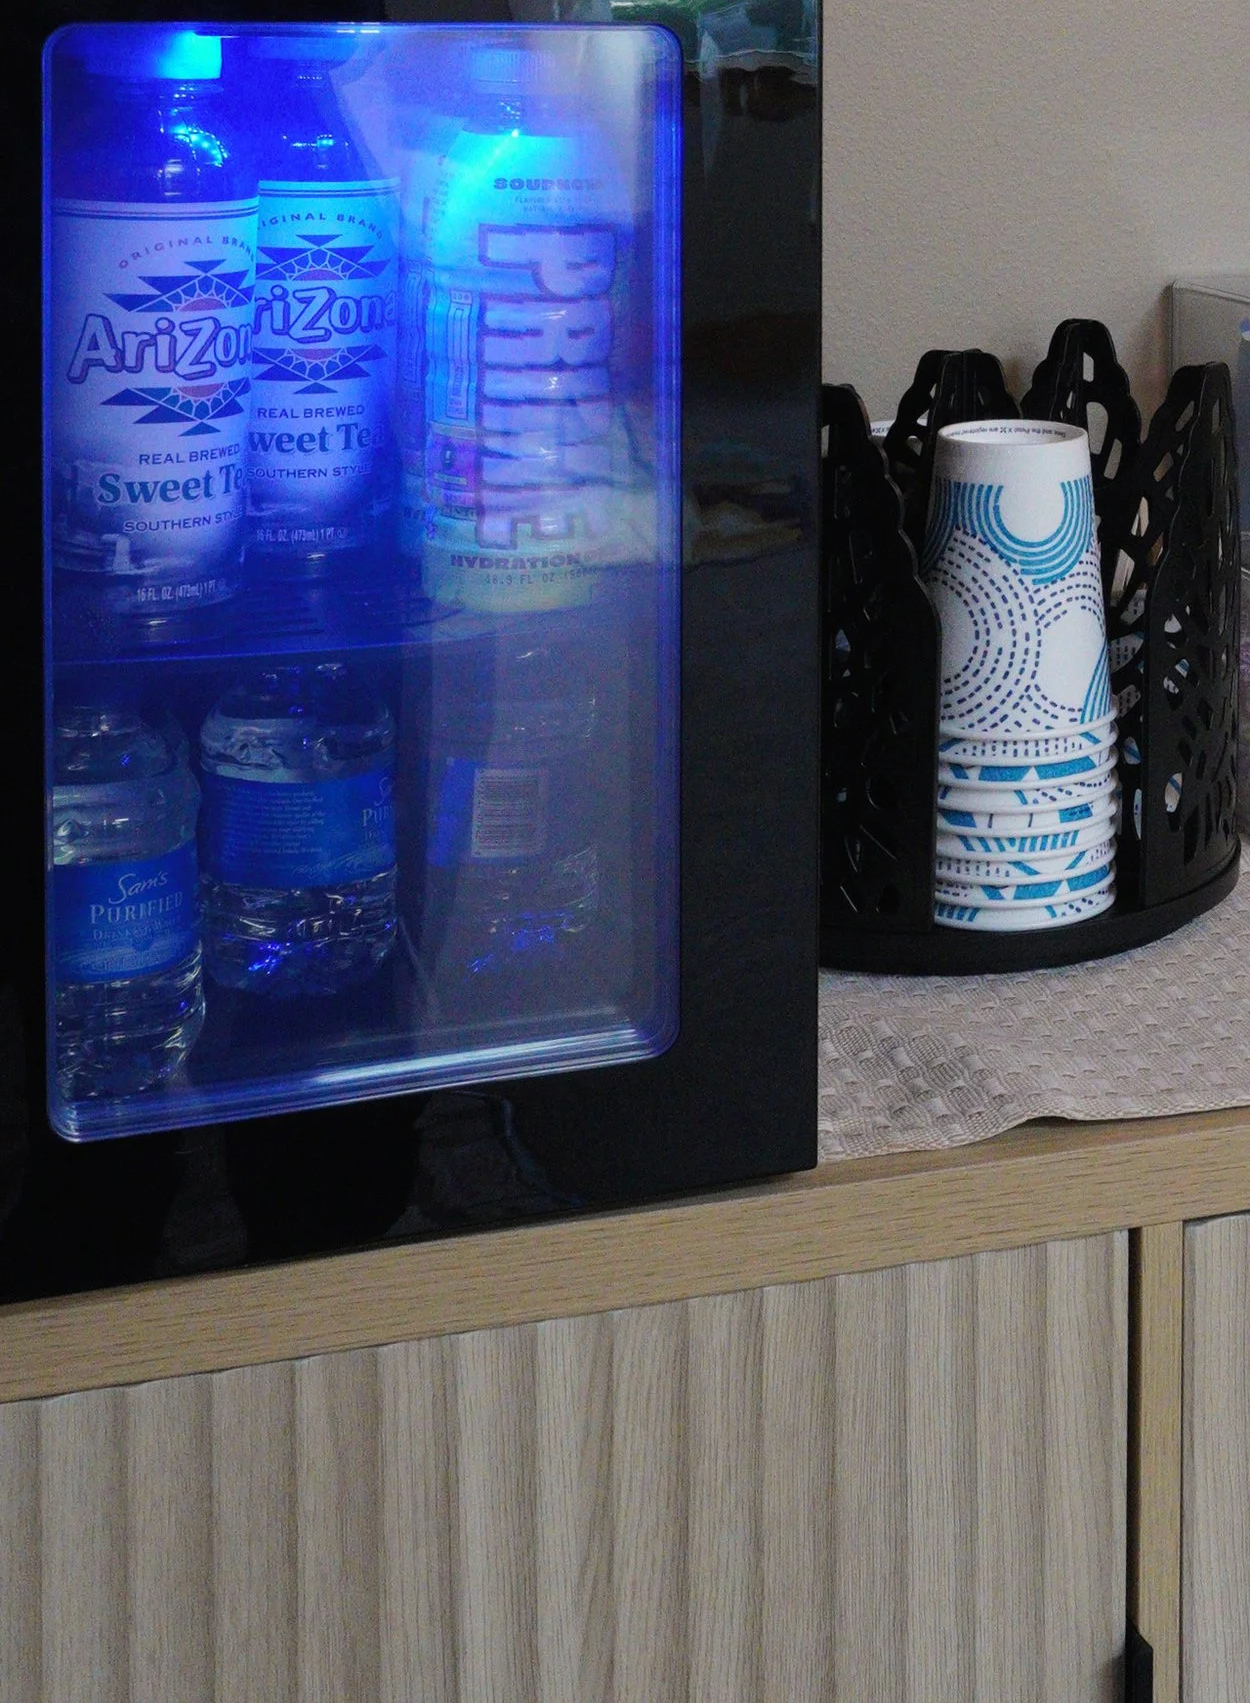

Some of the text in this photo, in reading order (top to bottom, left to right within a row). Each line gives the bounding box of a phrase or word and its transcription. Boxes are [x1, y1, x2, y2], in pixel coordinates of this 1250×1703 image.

[336, 213, 383, 240] BRAND
[119, 235, 213, 269] ORIGINAL
[254, 284, 397, 344] riZona
[66, 313, 252, 385] AriZon
[476, 221, 618, 550] PRIME
[257, 404, 366, 419] REAL BREWED
[248, 425, 330, 453] weet
[139, 443, 240, 465] REAL BREWED
[98, 462, 243, 503] Sweet Te
[247, 467, 328, 479] SOUTHERN
[124, 514, 212, 532] SOUTHERN
[450, 553, 581, 570] HYDRATION
[519, 574, 534, 585] FL
[541, 571, 556, 584] OZ
[136, 586, 146, 602] 16
[108, 870, 168, 905] Sam's
[89, 891, 184, 925] PURIFIED
